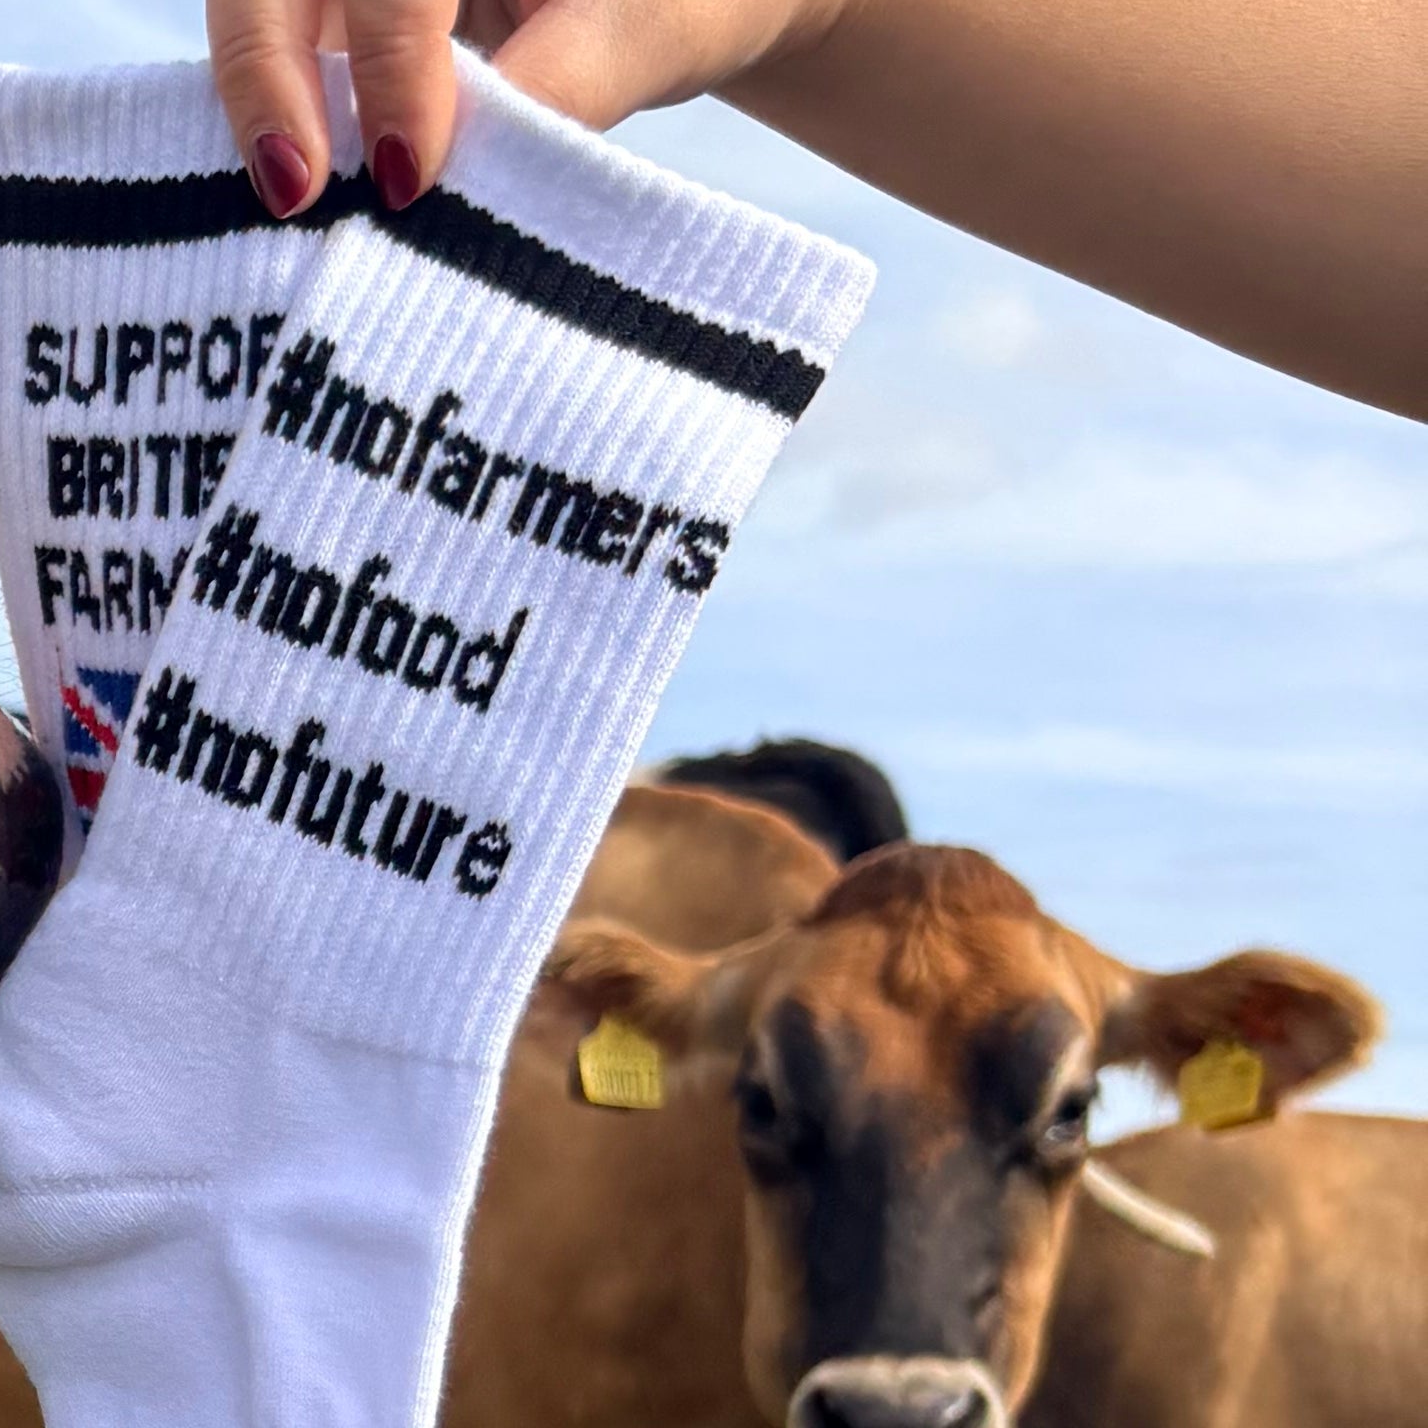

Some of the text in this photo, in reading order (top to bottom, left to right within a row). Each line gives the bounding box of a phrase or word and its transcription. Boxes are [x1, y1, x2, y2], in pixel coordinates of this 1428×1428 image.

[261, 329, 731, 597] #nofarmers
[191, 501, 530, 714] #nofood
[133, 665, 514, 902] #nofuture
